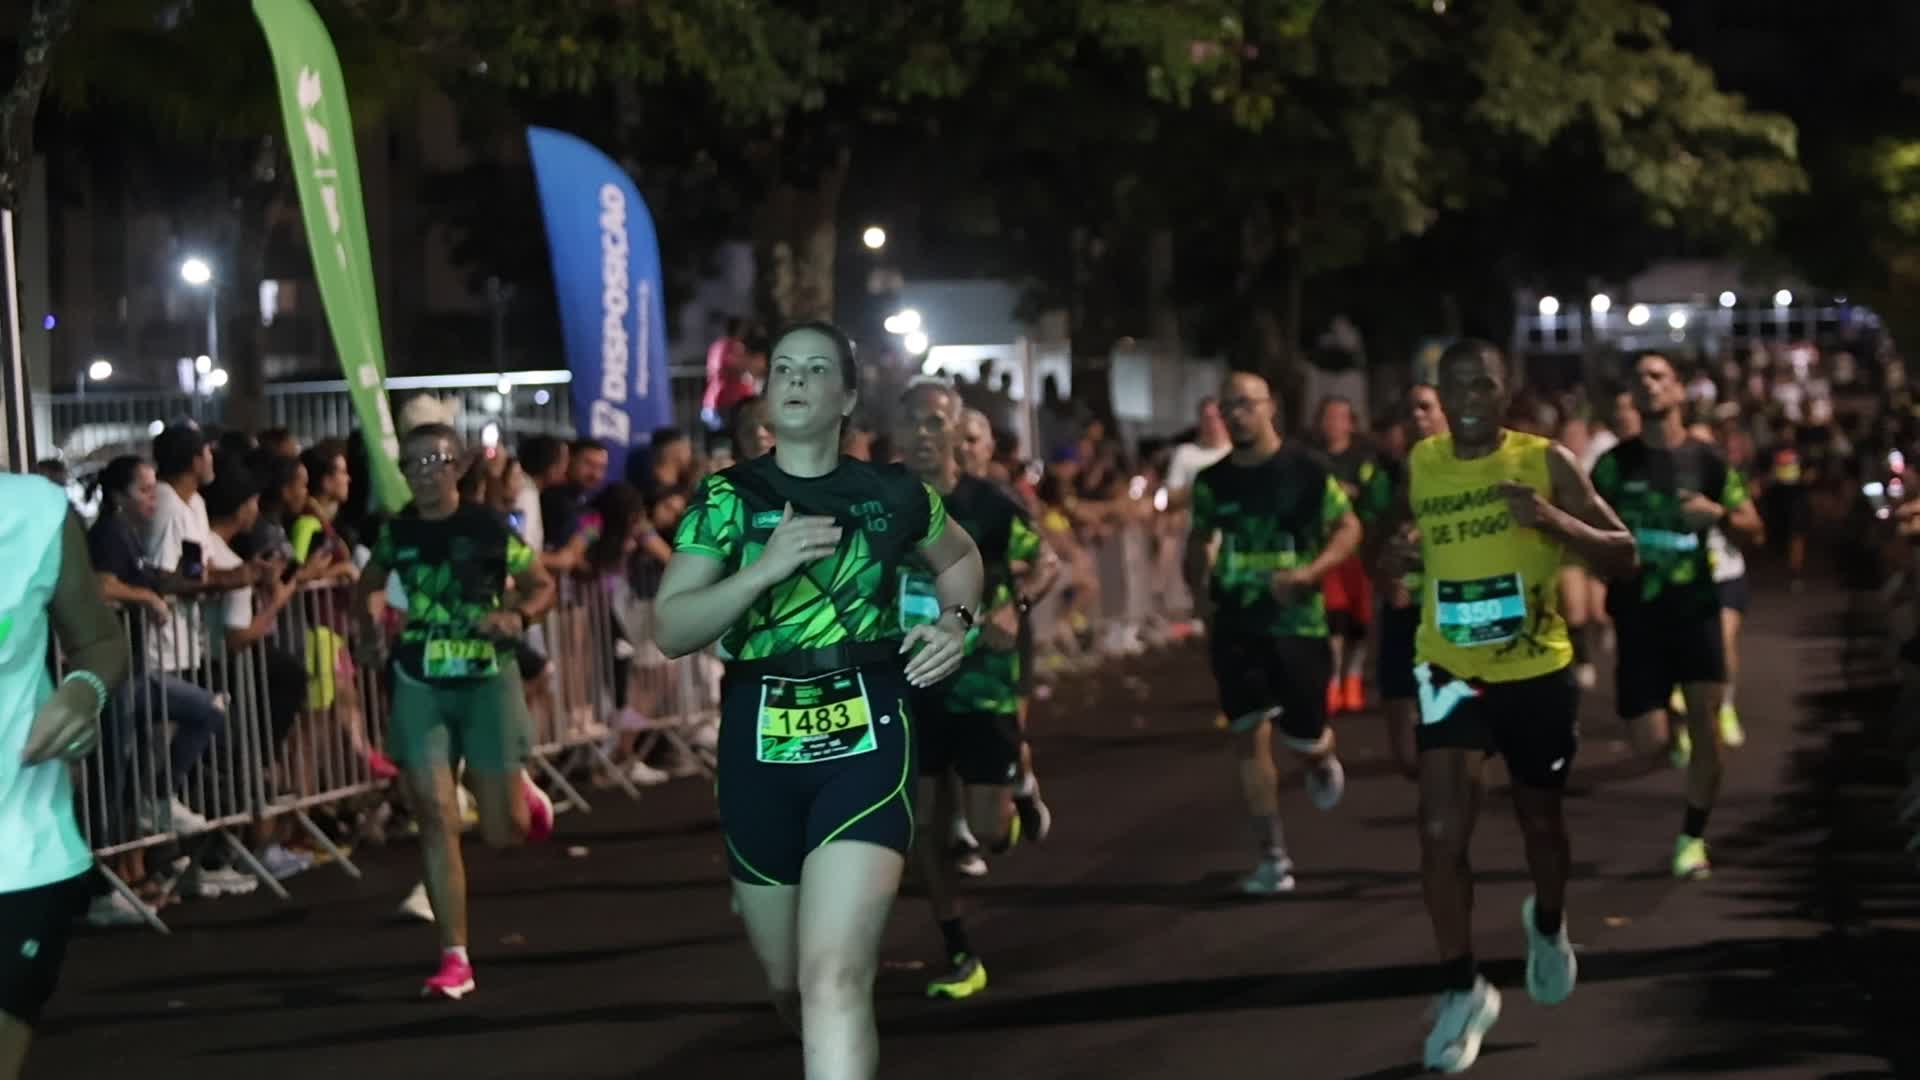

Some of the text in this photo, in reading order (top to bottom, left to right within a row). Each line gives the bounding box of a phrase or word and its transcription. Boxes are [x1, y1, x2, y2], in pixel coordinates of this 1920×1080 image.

[1431, 525, 1453, 544] DE
[1457, 512, 1509, 542] FOGO
[1458, 599, 1502, 624] 350
[778, 703, 851, 735] 1483
